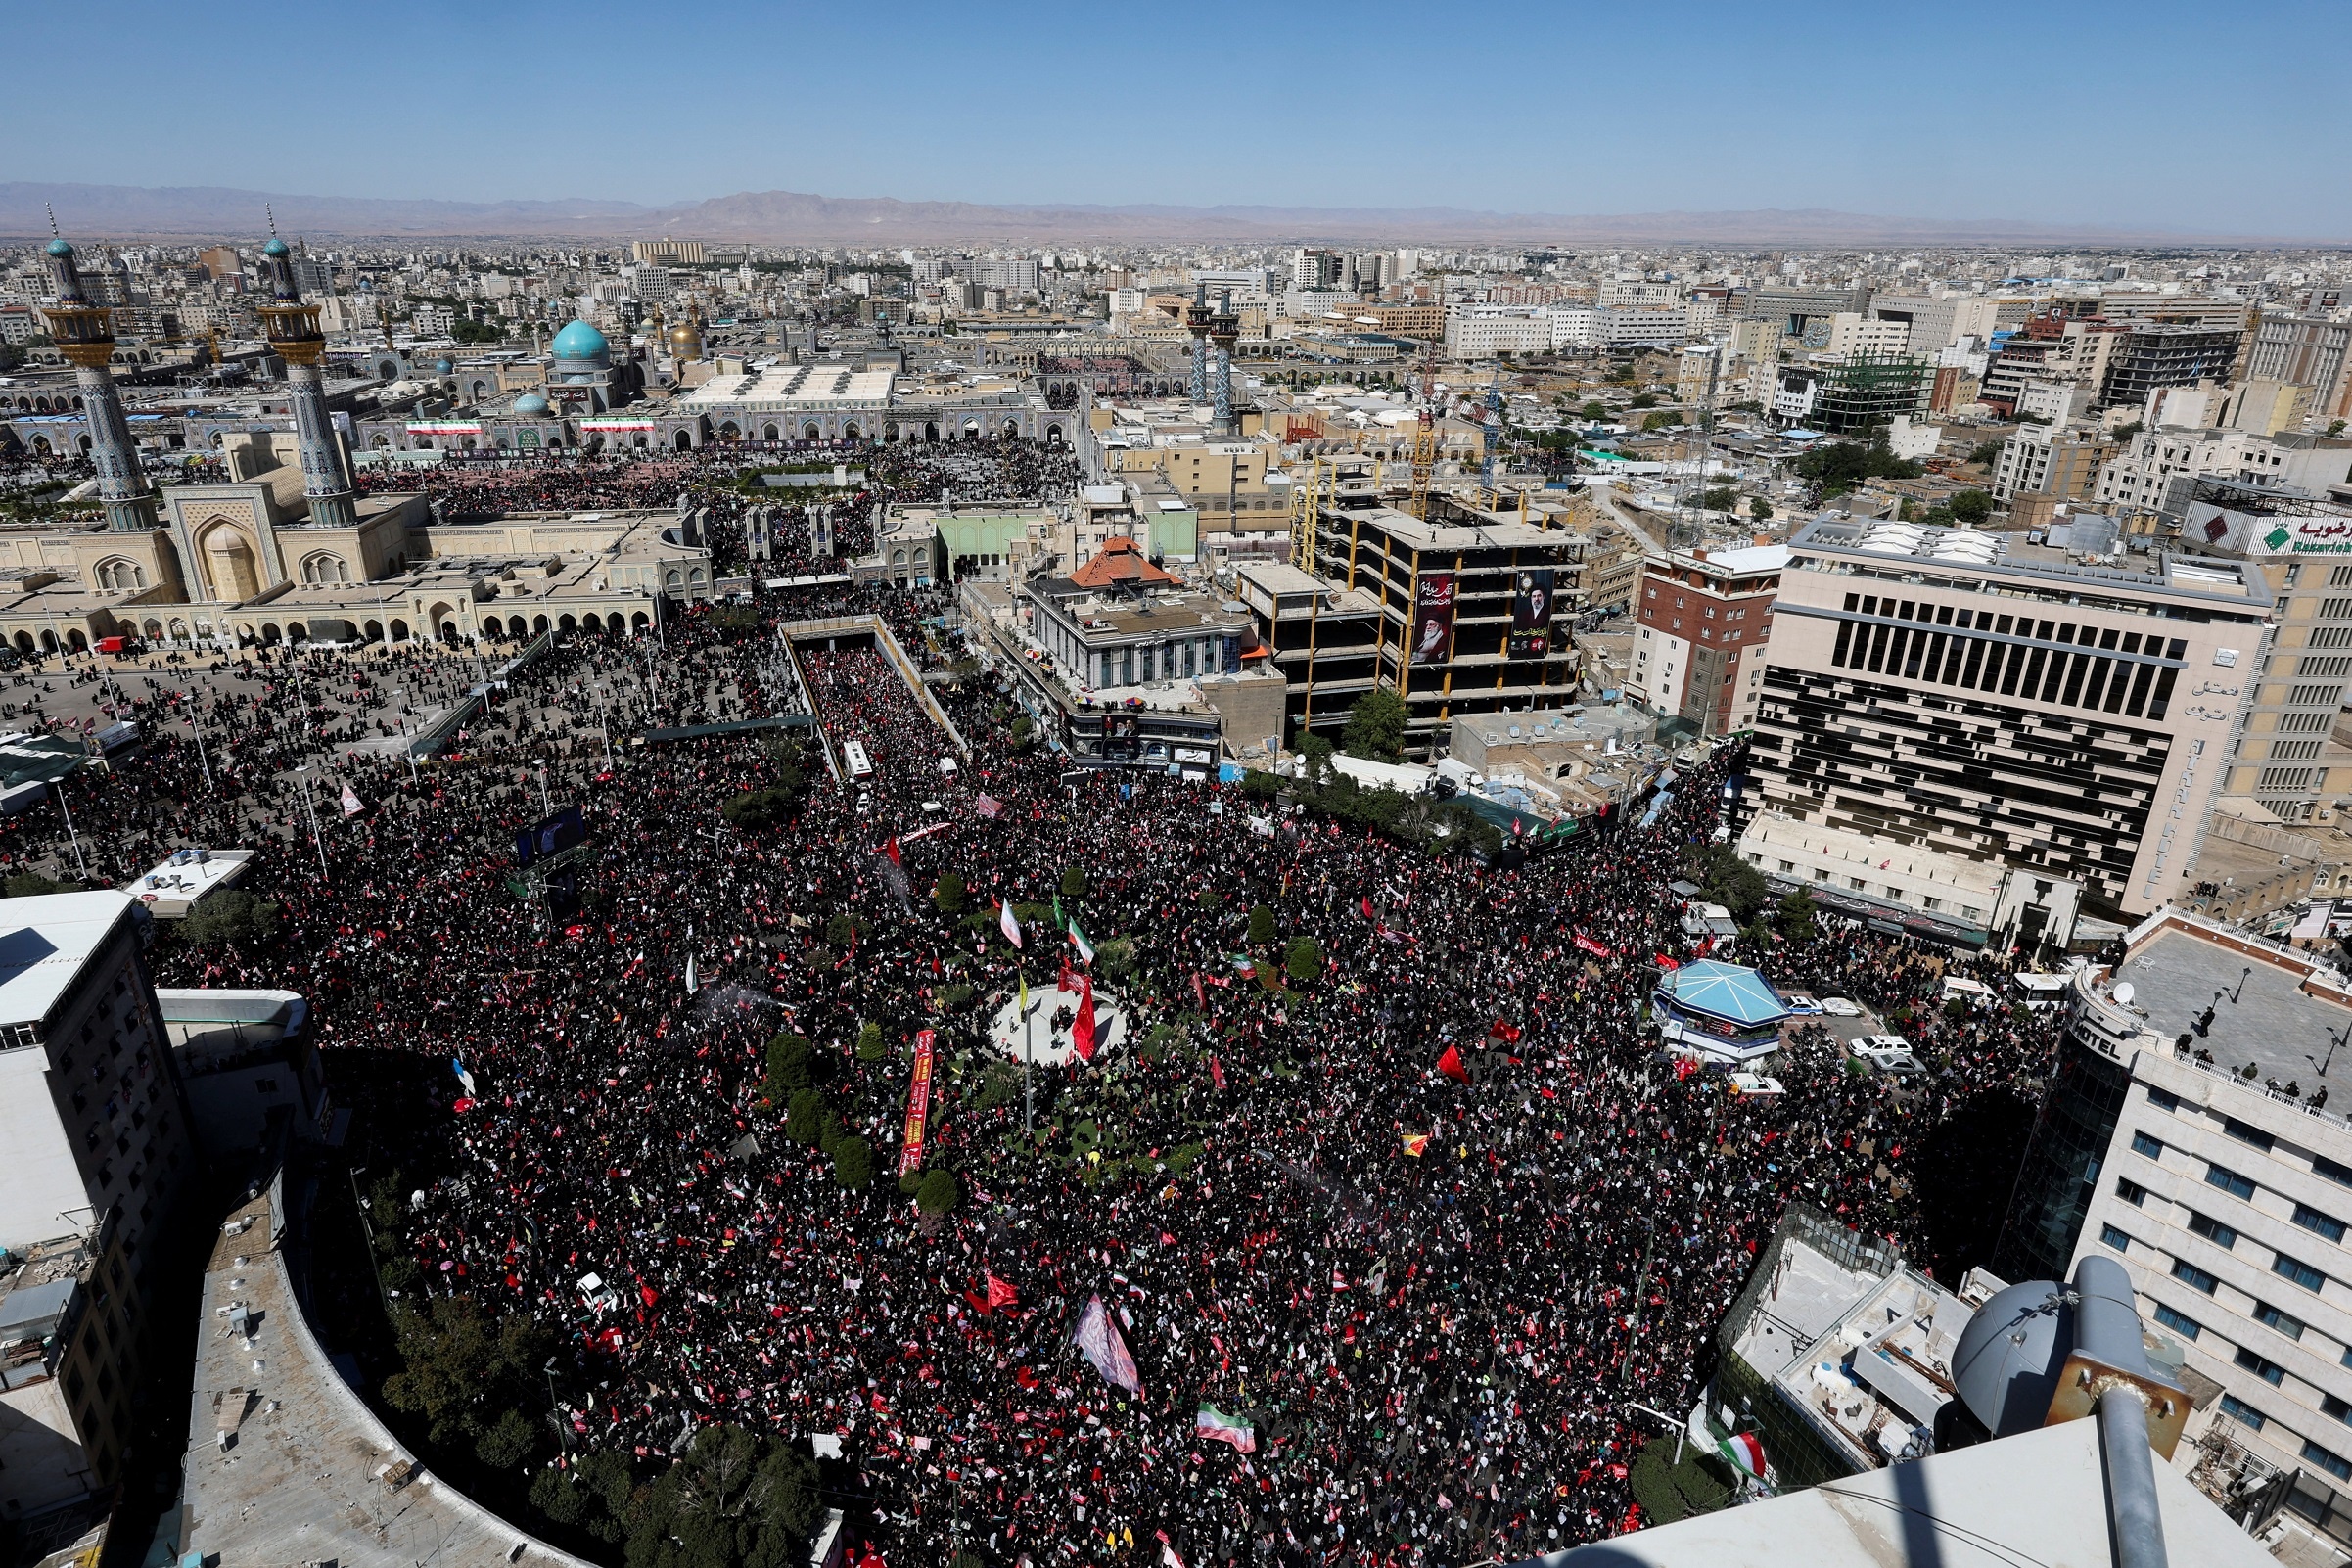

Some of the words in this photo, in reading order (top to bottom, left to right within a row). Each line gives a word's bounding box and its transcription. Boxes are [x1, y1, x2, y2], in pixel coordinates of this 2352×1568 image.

[2191, 680, 2238, 696] هتل
[2143, 821, 2177, 899] HOTEL
[1576, 937, 1589, 949] Kill
[2074, 1022, 2121, 1060] HOTEL
